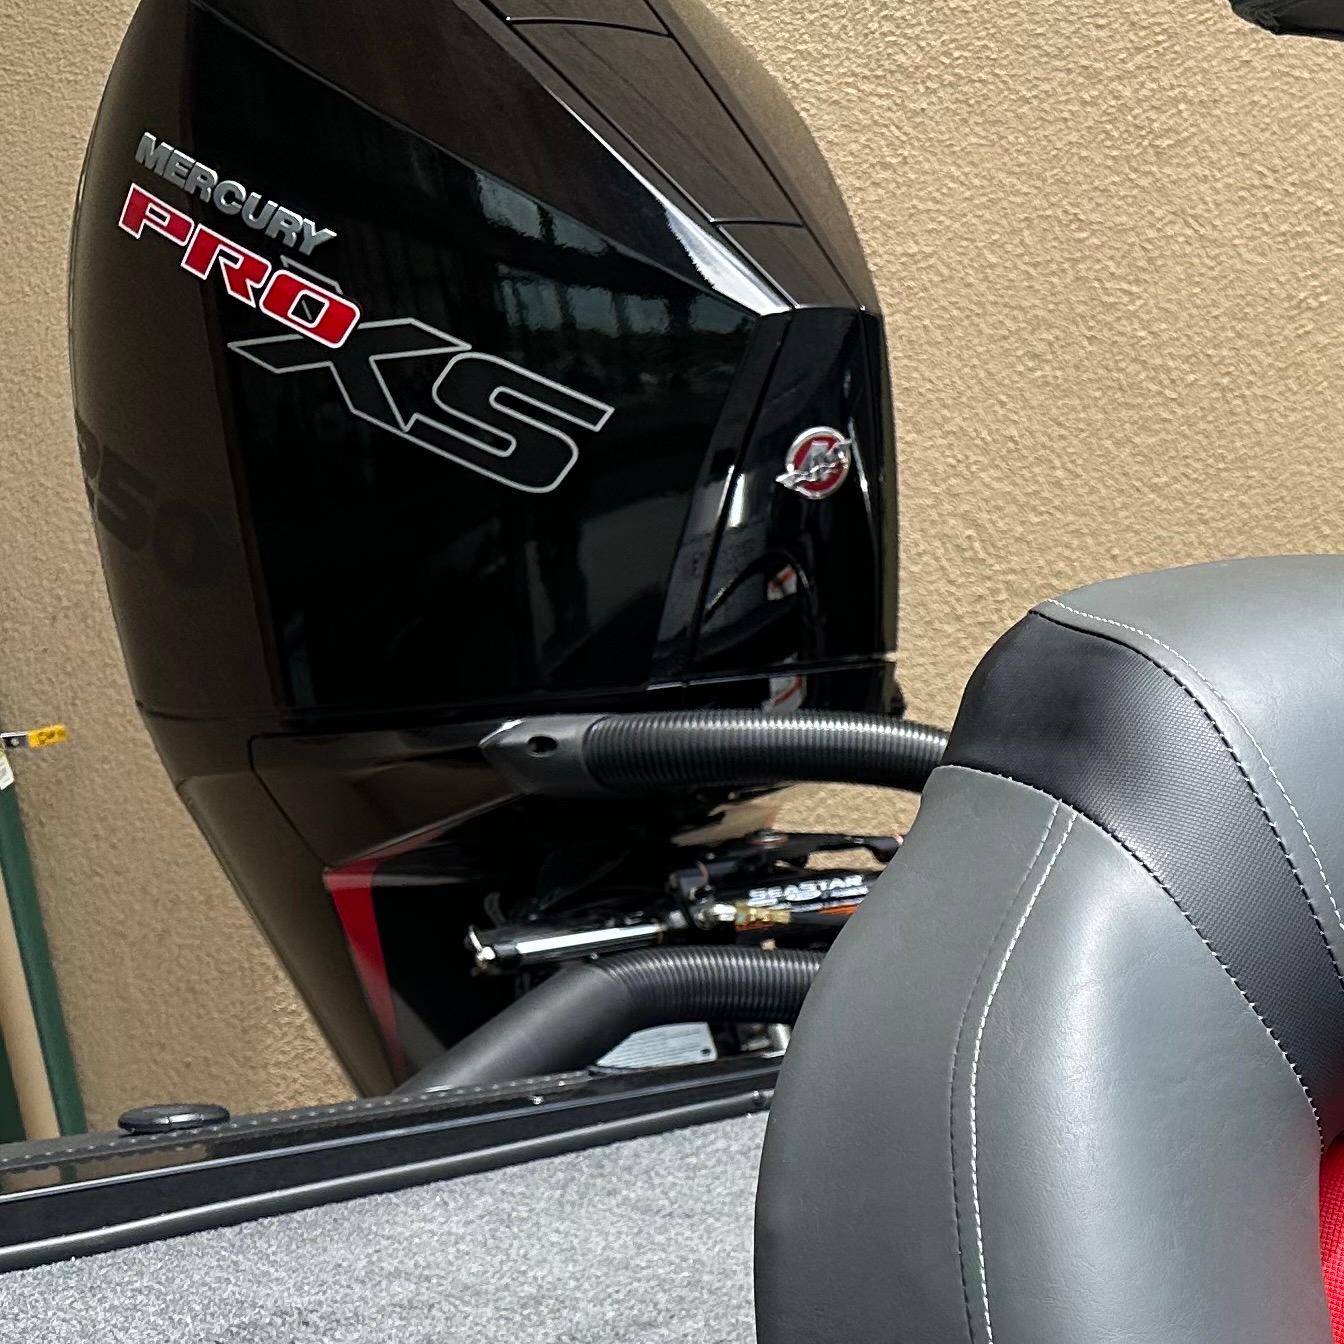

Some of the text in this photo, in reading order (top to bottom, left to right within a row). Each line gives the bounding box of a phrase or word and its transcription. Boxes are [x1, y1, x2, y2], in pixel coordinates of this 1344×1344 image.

[118, 182, 361, 349] PRO
[135, 131, 337, 256] MERCURY
[227, 255, 616, 494] XS
